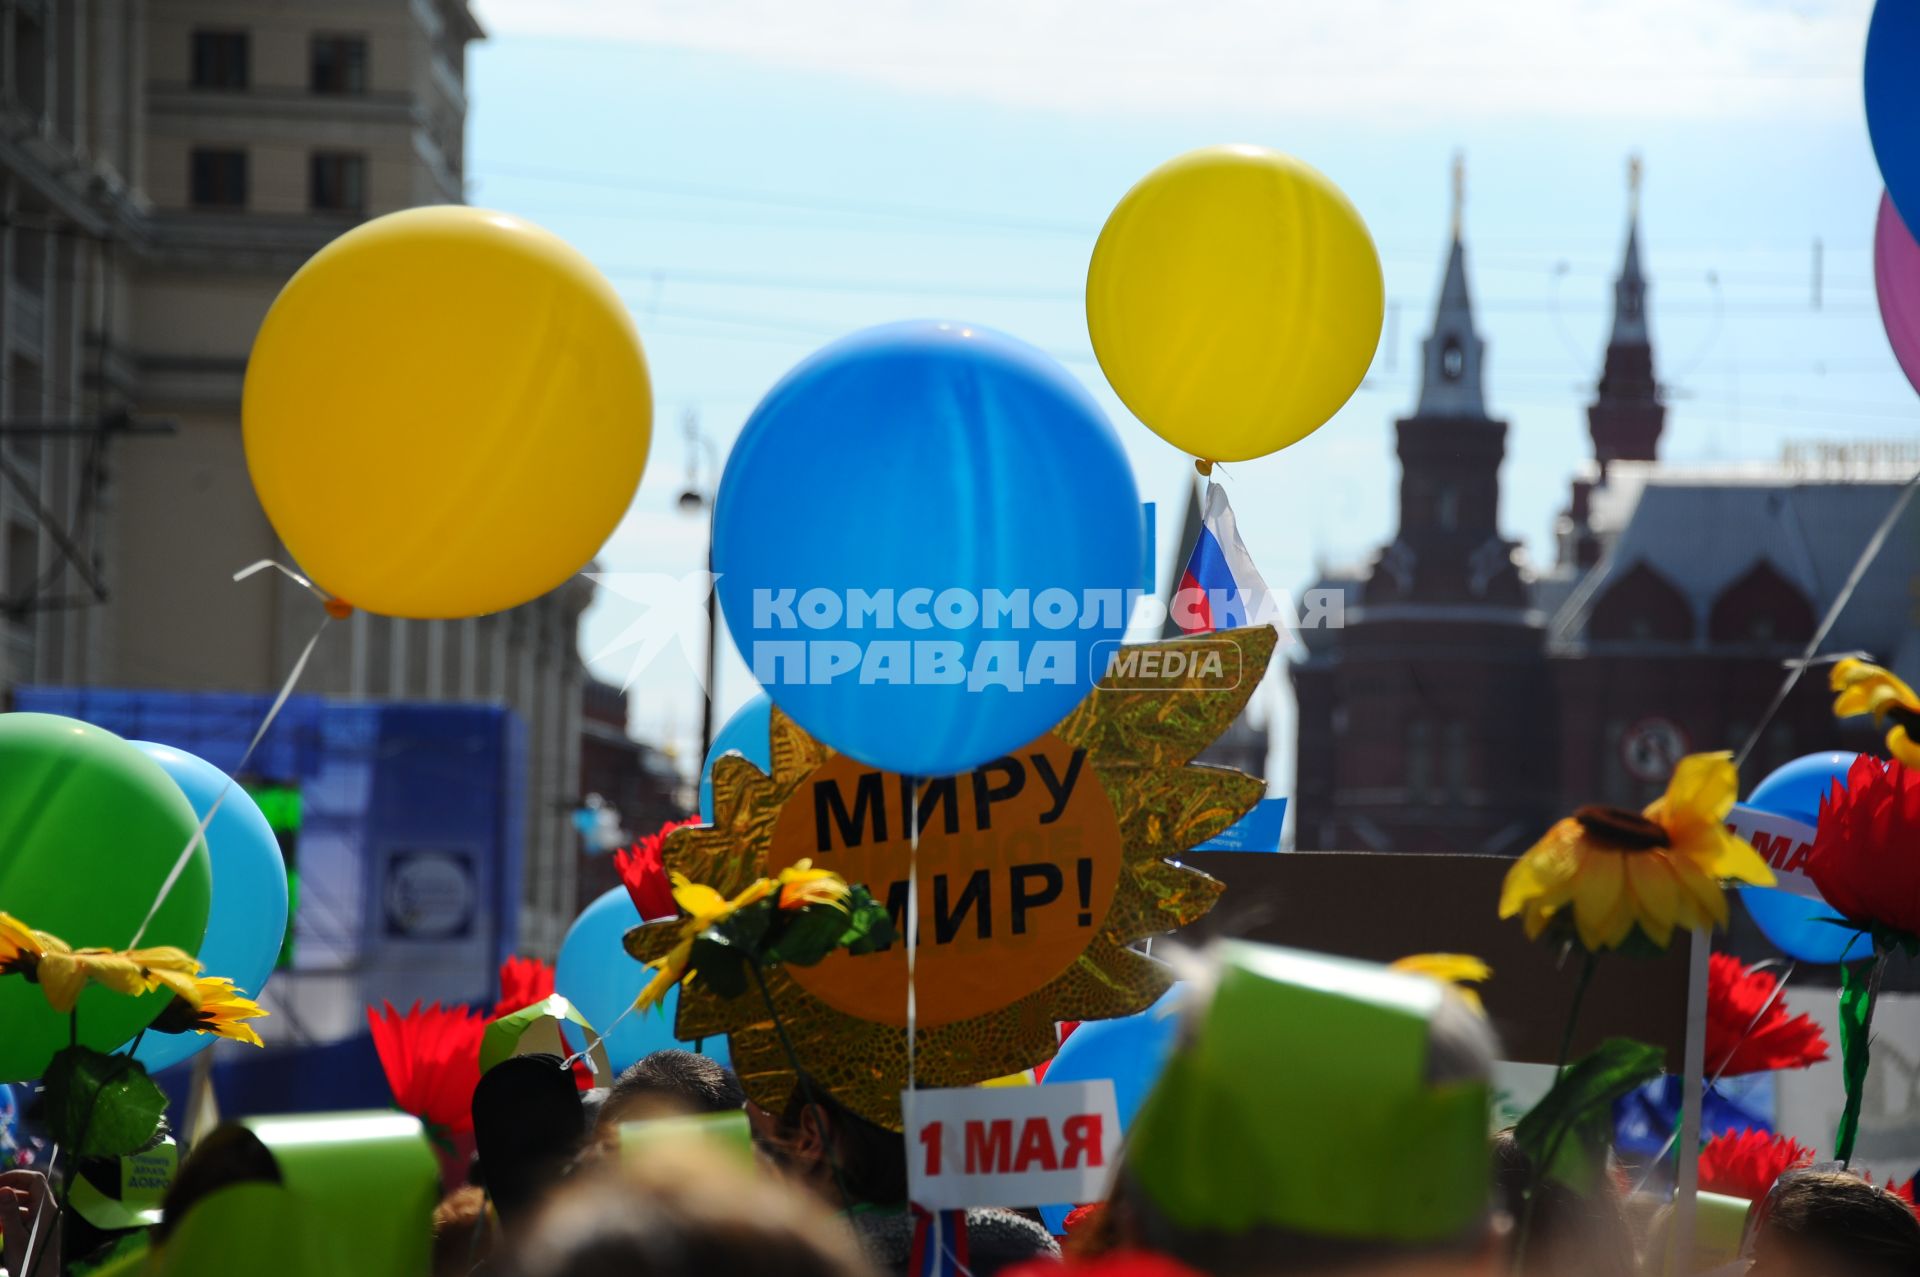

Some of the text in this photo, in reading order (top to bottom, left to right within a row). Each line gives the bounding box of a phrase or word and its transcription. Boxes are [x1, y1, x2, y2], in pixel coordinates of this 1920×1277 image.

[813, 749, 1088, 852] МИРУ
[1750, 830, 1812, 873] МА
[919, 1114, 1104, 1176] 1 МАЯ
